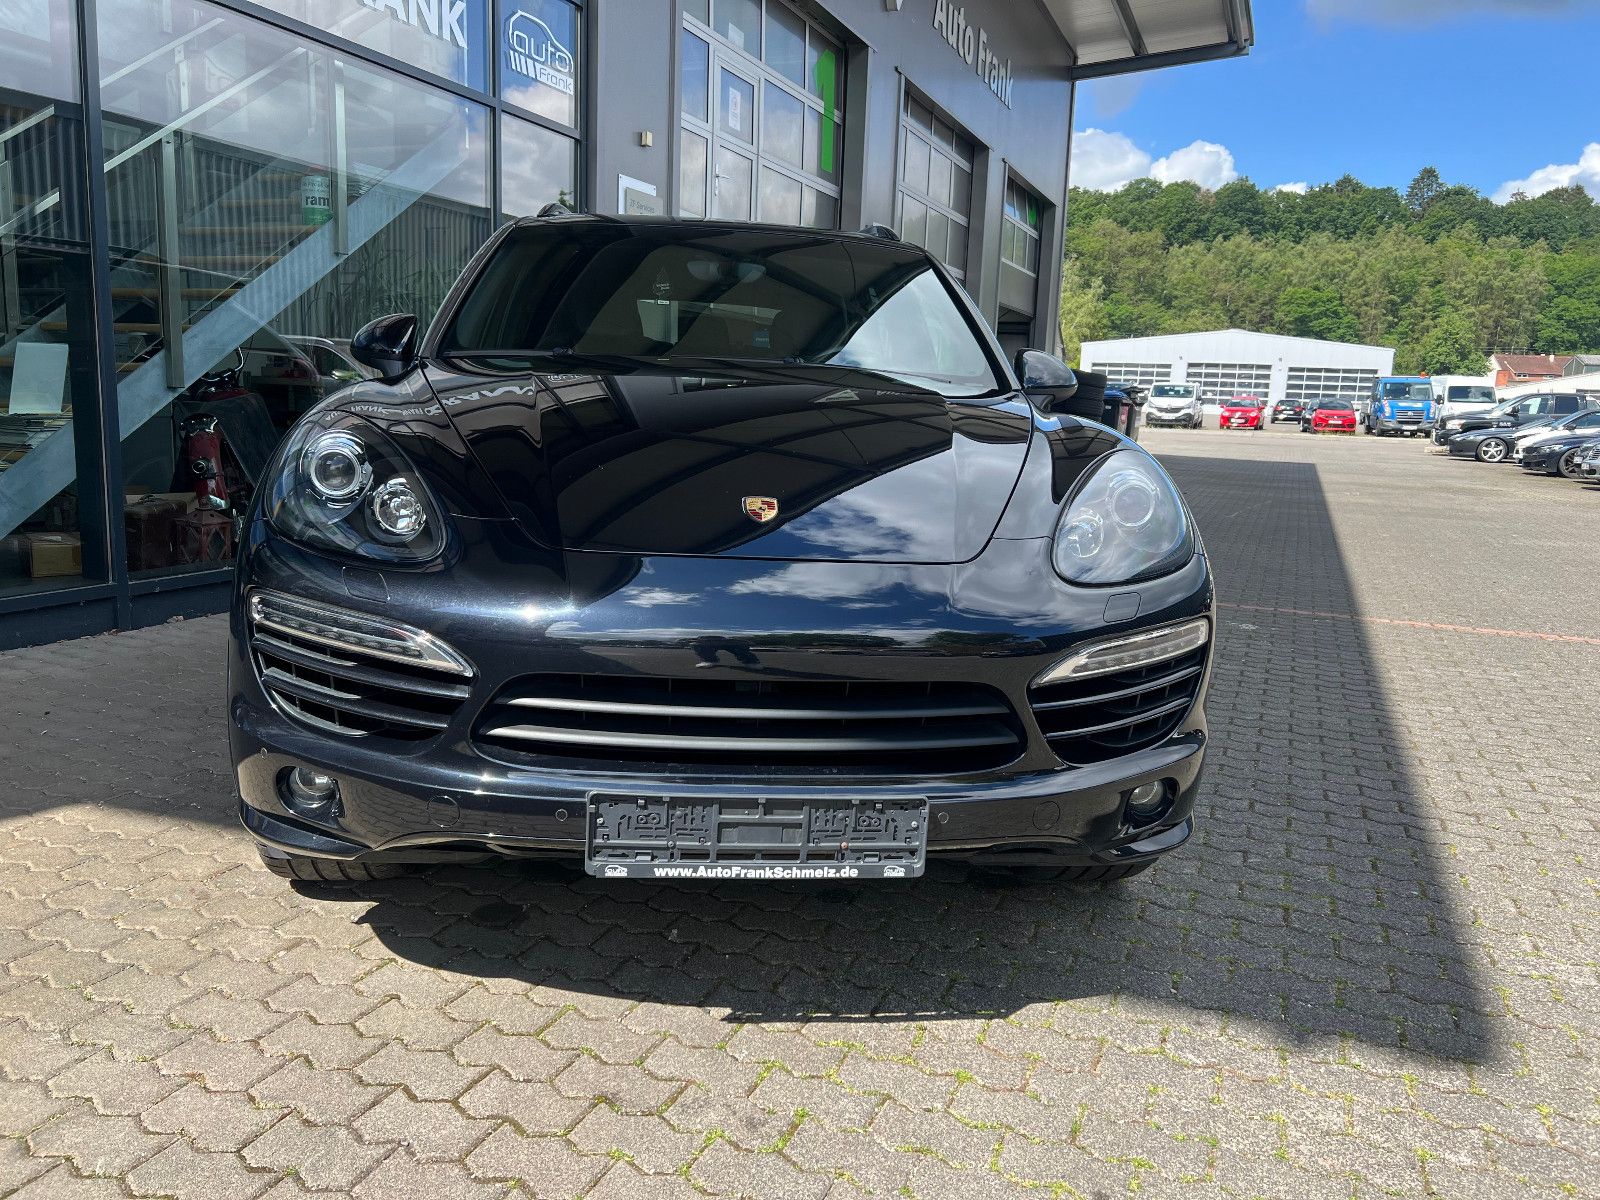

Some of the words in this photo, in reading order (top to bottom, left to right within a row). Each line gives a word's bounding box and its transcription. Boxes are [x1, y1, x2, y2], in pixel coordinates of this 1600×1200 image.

[513, 30, 570, 73] auto
[933, 0, 974, 65] Auto
[976, 28, 1014, 110] Frank
[539, 67, 572, 92] Frank
[653, 866, 859, 878] www.AutoFrankSchmelz.de
